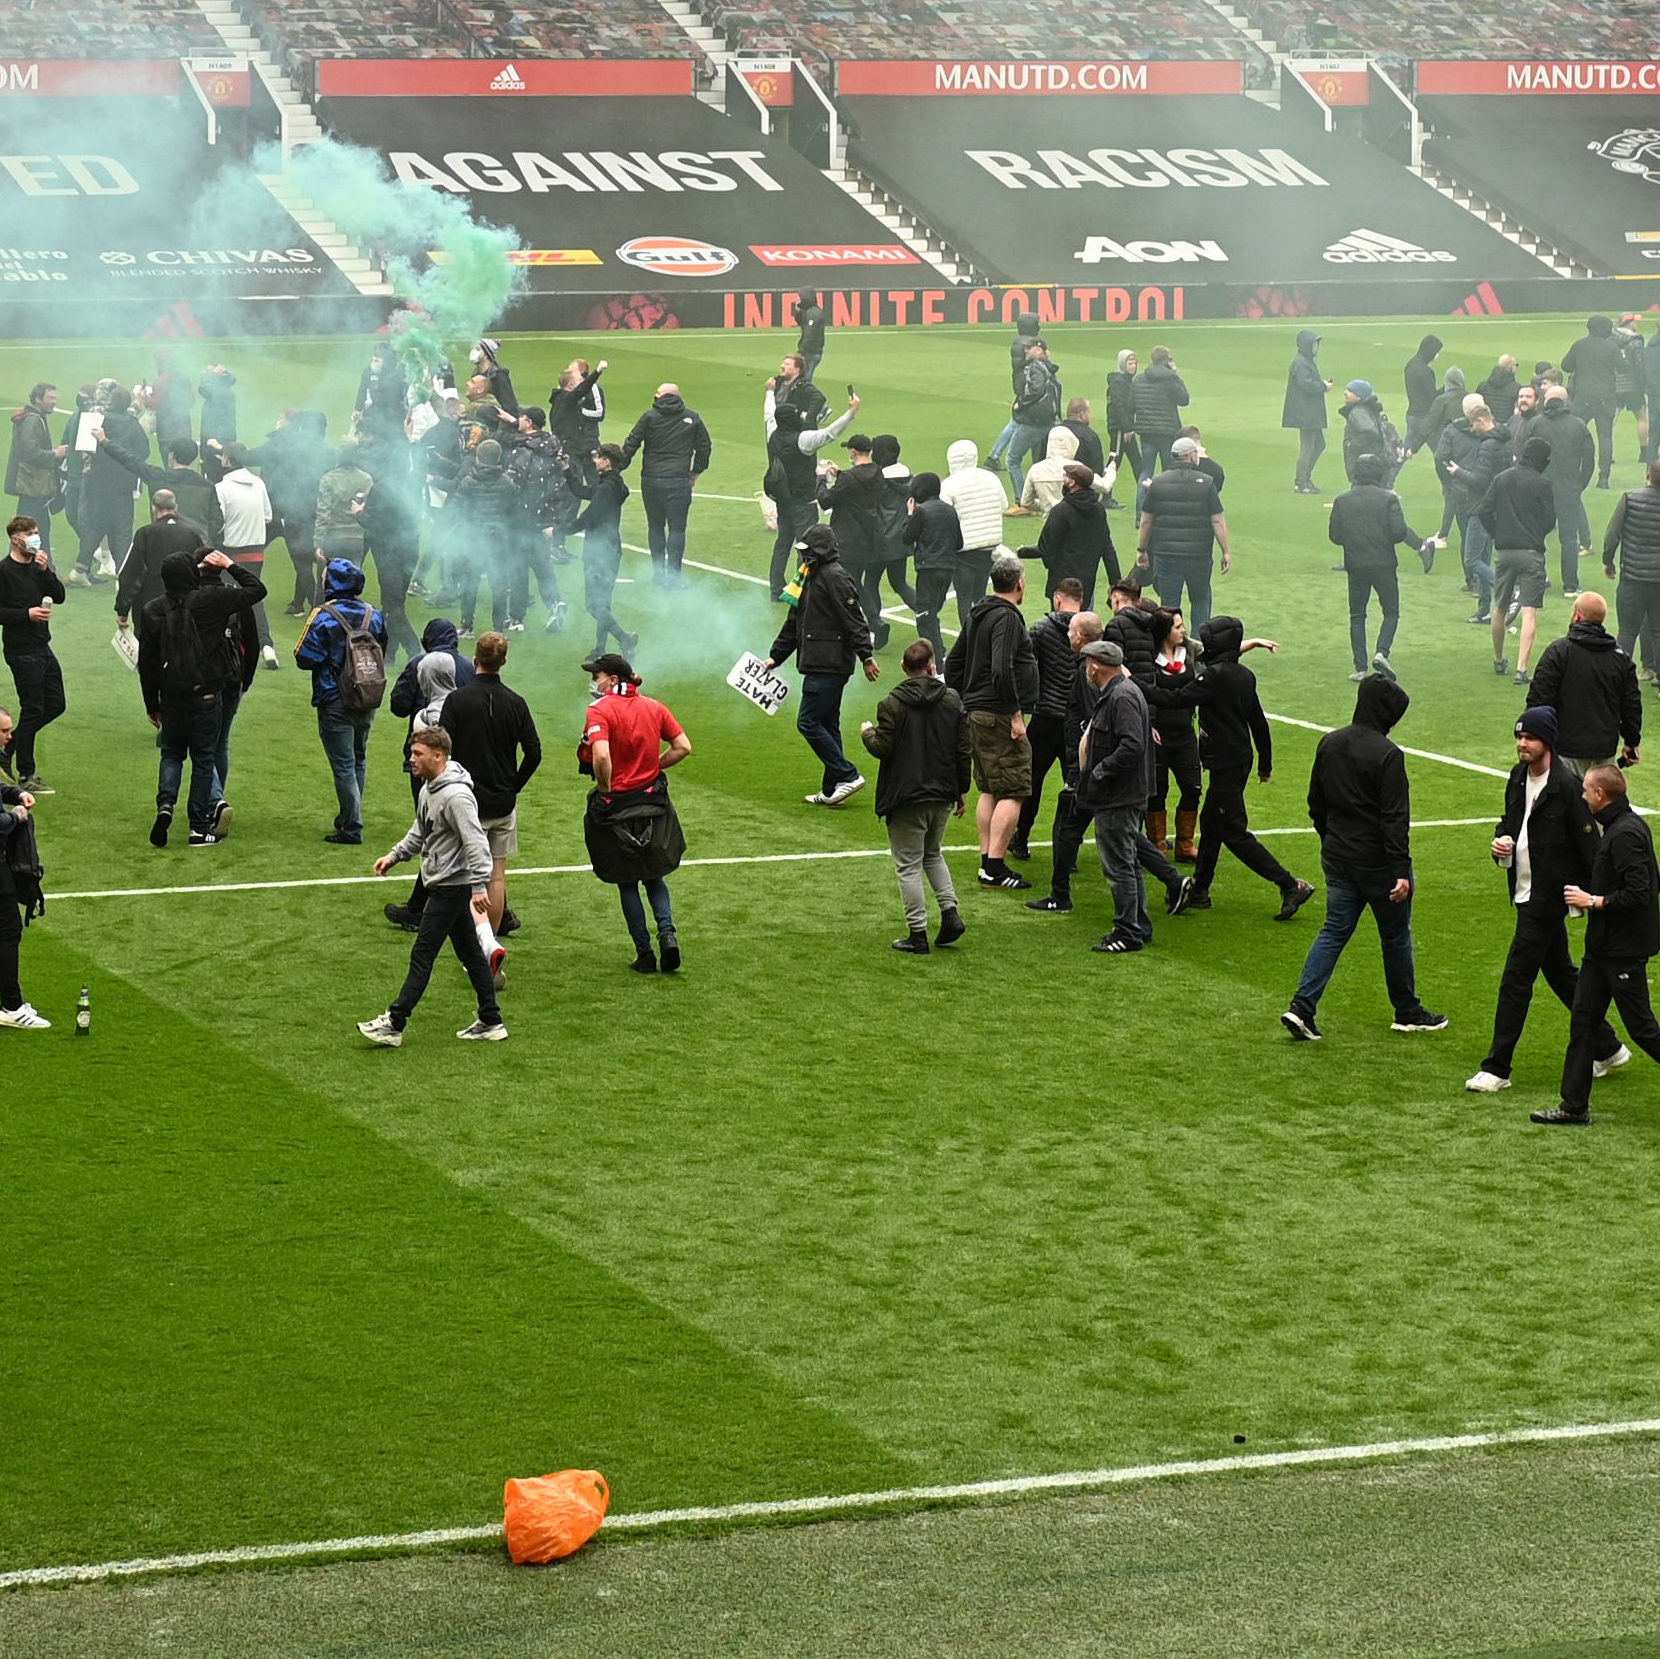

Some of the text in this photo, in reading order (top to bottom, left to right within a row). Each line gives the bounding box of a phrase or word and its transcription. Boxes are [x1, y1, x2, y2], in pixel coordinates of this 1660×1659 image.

[490, 79, 526, 90] adidas
[935, 64, 1148, 90] MANUTD.COM
[388, 151, 784, 192] AGAINST
[964, 149, 1330, 189] RACISM
[147, 249, 314, 265] CHIVAS
[626, 250, 728, 262] Gulf
[760, 248, 908, 262] KONAMI
[1074, 236, 1228, 264] AON
[1323, 246, 1457, 264] adidas
[110, 267, 323, 277] BLENDED SCOTCH WHISKY
[967, 287, 1184, 325] CONTROL
[745, 659, 788, 700] GLAZER
